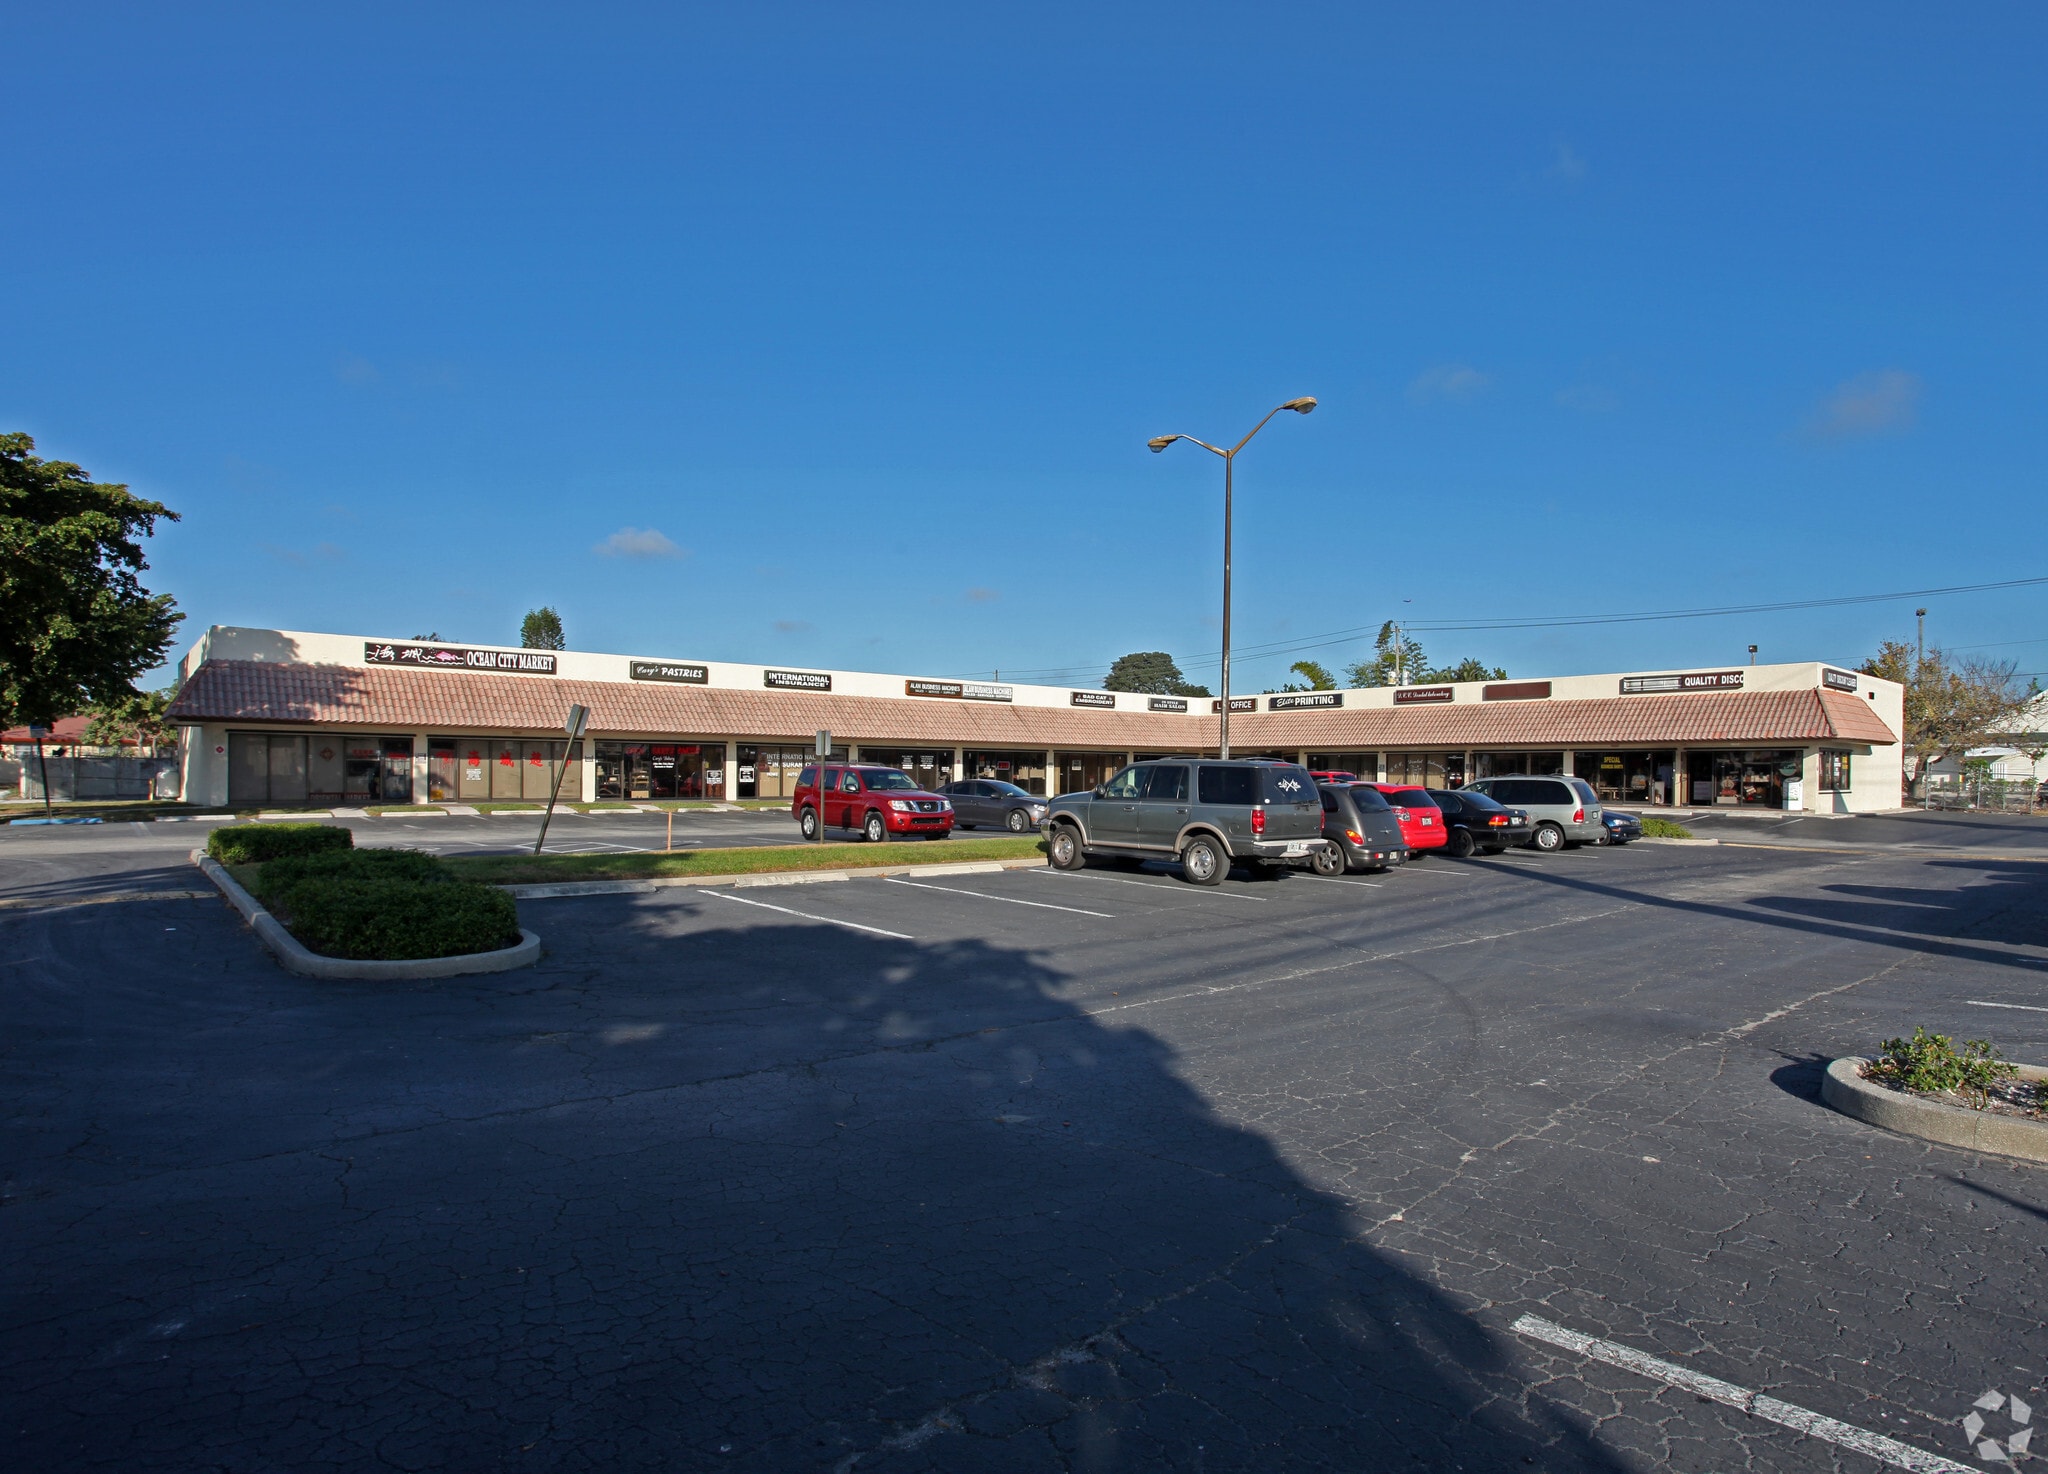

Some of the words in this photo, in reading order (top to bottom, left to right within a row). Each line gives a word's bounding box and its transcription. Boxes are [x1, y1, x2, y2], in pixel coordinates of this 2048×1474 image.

[467, 652, 497, 668] OCEAN
[498, 653, 519, 669] CITY
[519, 654, 554, 671] MARKET
[661, 667, 703, 679] PASTRIES
[768, 672, 829, 683] INTERNATIONAL
[1684, 675, 1718, 686] QUALITY
[922, 683, 941, 691] BUSINESS
[1075, 697, 1114, 705] EMBROIDERY
[1230, 700, 1252, 709] OFFICE
[1277, 697, 1294, 707] Elite
[1295, 695, 1334, 706] PRINTING
